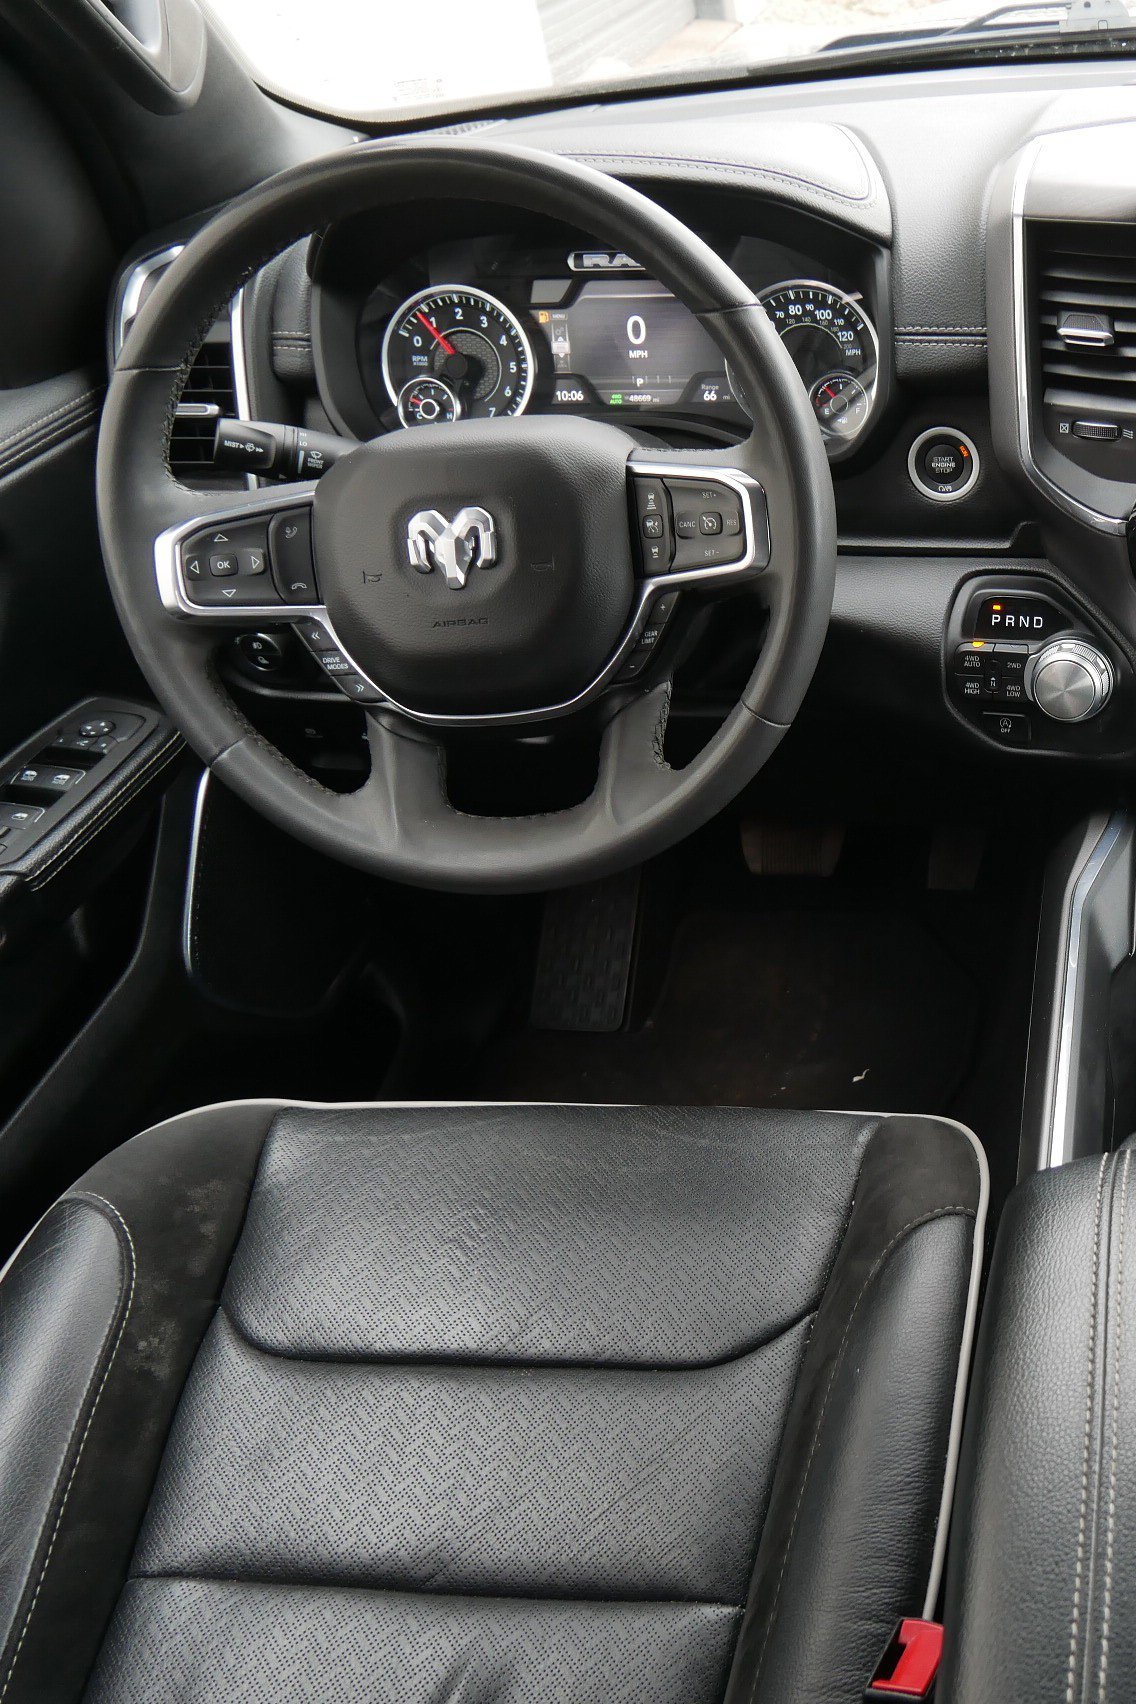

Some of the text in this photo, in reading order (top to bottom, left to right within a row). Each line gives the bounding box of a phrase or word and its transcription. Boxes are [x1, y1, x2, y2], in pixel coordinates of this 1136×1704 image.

[583, 254, 643, 267] RA
[454, 308, 464, 319] 2
[775, 311, 784, 319] 70
[788, 305, 802, 316] 80
[815, 310, 832, 321] 100
[430, 316, 436, 328] 1
[480, 316, 488, 328] 3
[834, 318, 845, 326] 110
[626, 315, 646, 345] 0
[499, 335, 508, 346] 4
[837, 331, 854, 341] 120
[413, 336, 422, 347] 0
[629, 350, 648, 358] MPH
[509, 362, 517, 373] 5
[636, 377, 644, 387] P
[504, 386, 512, 397] 6
[701, 384, 719, 392] Range
[555, 391, 584, 401] 10:06
[703, 391, 717, 401] 66
[416, 412, 423, 420] C
[489, 407, 497, 417] 7
[224, 439, 240, 449] MIST
[679, 520, 696, 528] CANC
[217, 560, 231, 570] OK
[432, 617, 489, 628] AIRBAG
[322, 656, 341, 664] DRIVE
[964, 687, 980, 695] HIGH
[1006, 690, 1021, 698] LOW
